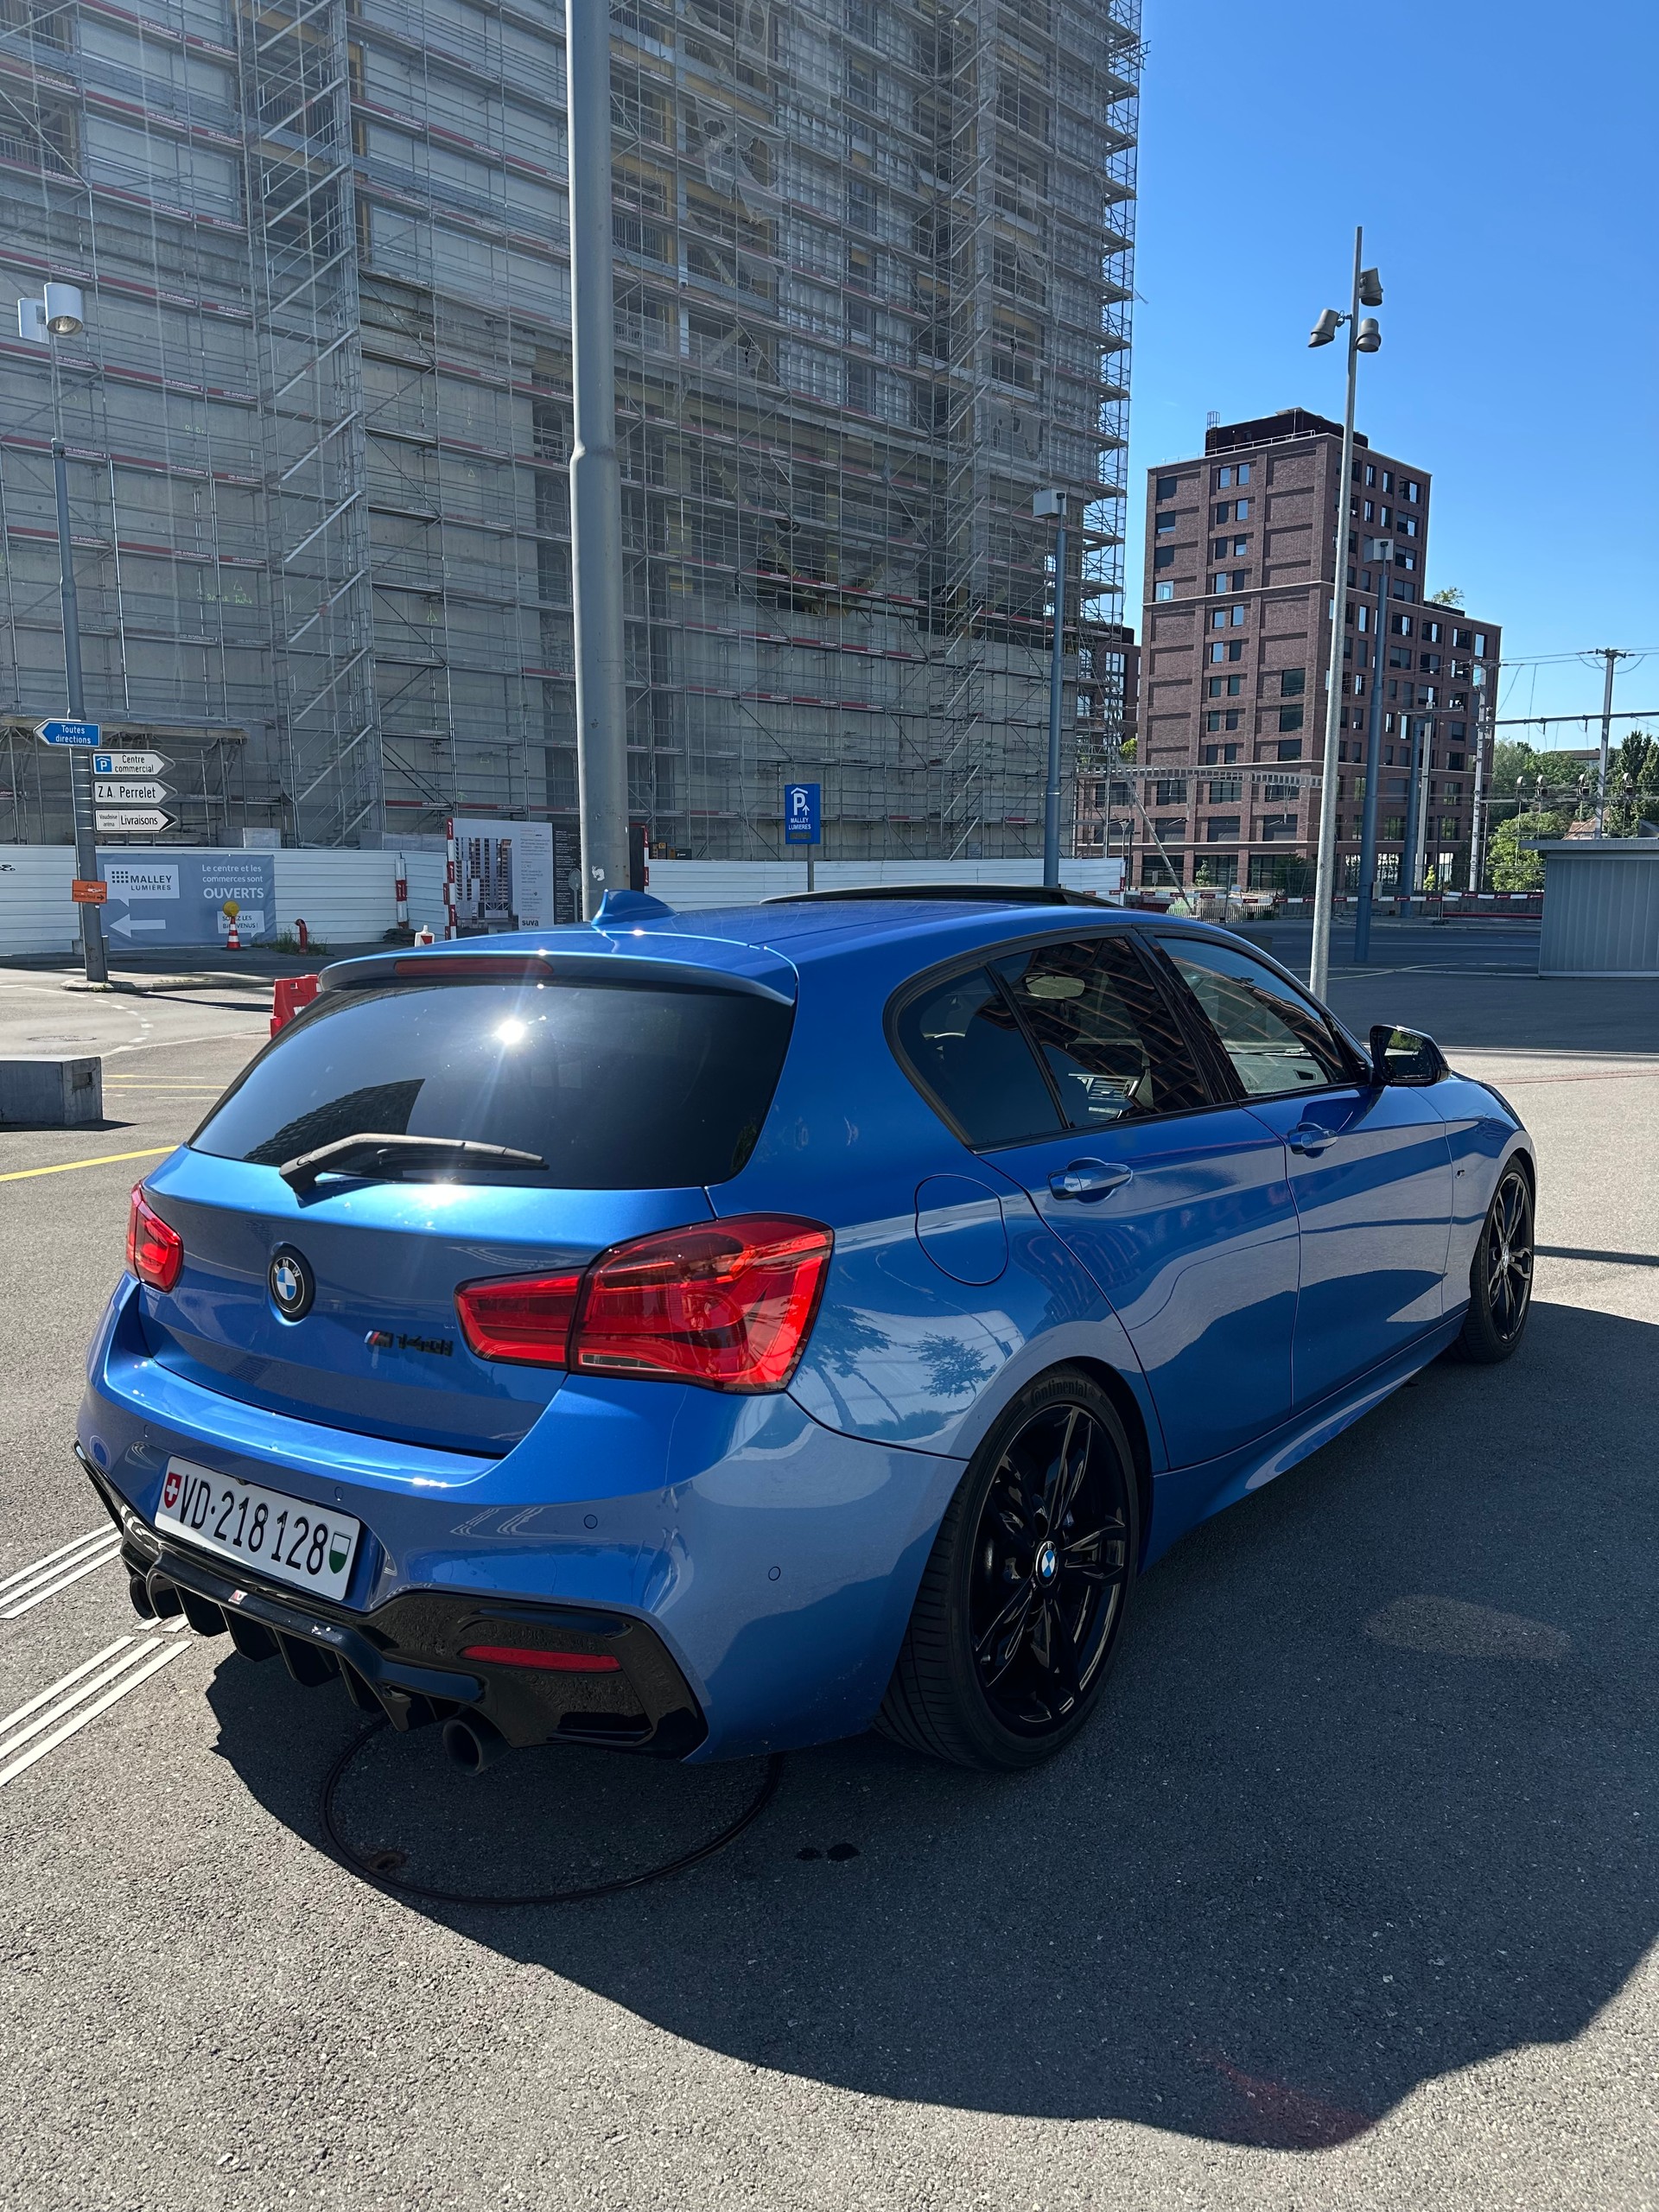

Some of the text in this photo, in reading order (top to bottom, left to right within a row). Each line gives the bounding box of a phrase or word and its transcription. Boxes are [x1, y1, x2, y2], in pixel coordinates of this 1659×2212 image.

[61, 725, 86, 734] Toutes
[55, 735, 92, 745] directions
[122, 754, 145, 764] Centre
[100, 760, 108, 771] P
[114, 765, 154, 773] commercial
[119, 786, 156, 798] Perrelet
[793, 792, 806, 816] P
[120, 815, 158, 825] Livraisons
[203, 887, 264, 899] OUVERTS
[274, 1259, 300, 1277] BMW
